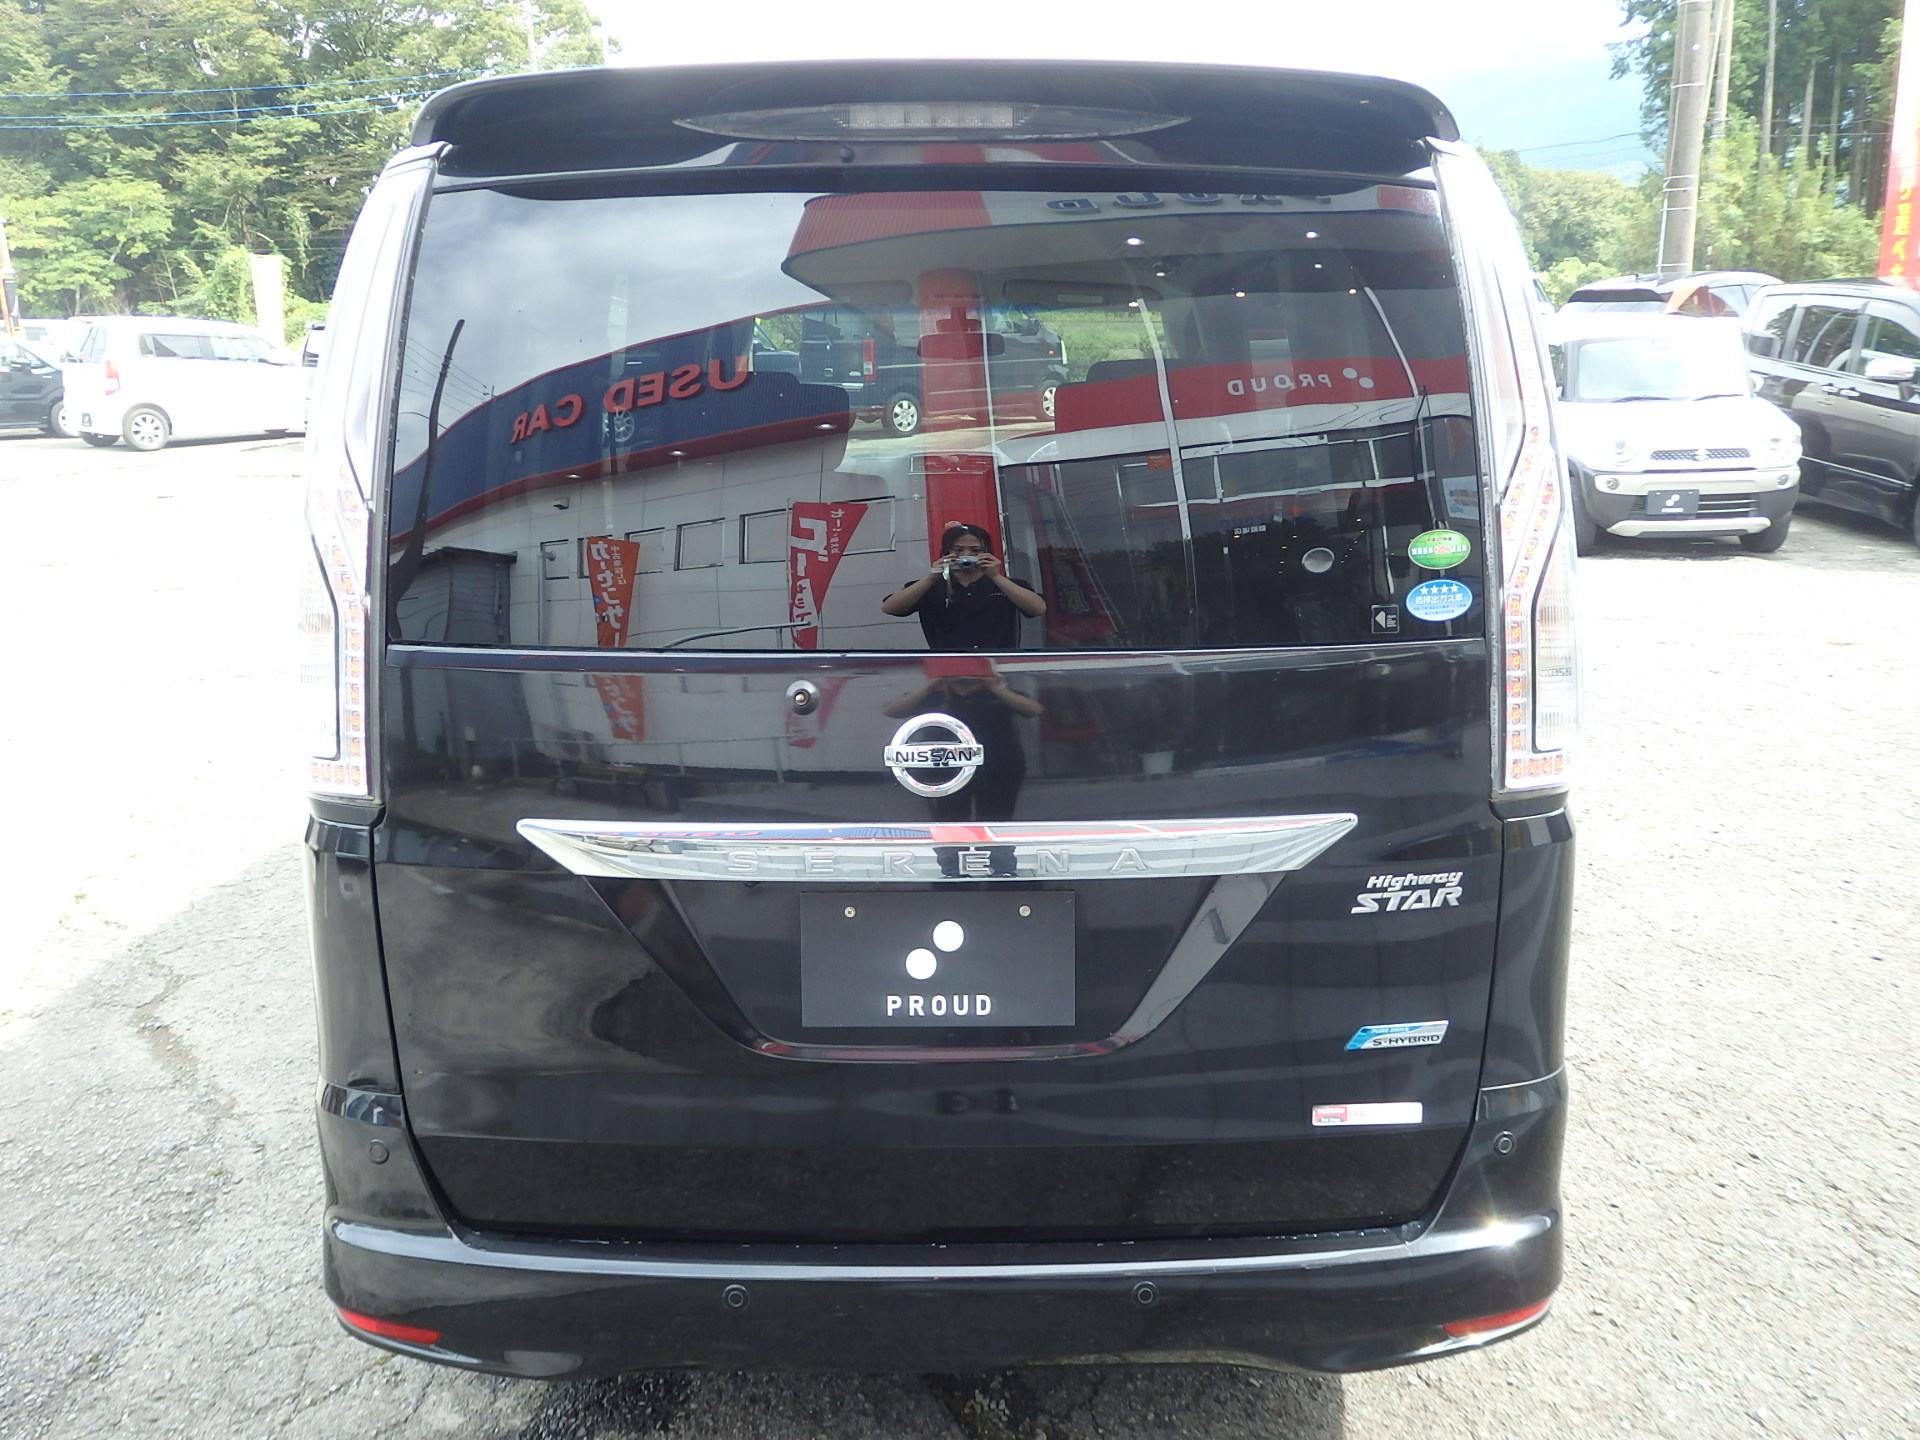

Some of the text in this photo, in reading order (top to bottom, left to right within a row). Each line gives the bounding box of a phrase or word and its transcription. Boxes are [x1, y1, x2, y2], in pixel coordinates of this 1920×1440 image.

[895, 750, 973, 763] NISSAN
[727, 848, 1149, 876] SERENA
[1366, 871, 1463, 892] Highway
[1350, 886, 1463, 914] STAR
[887, 995, 992, 1016] PROUD
[1373, 1034, 1440, 1046] S-HYBRID
